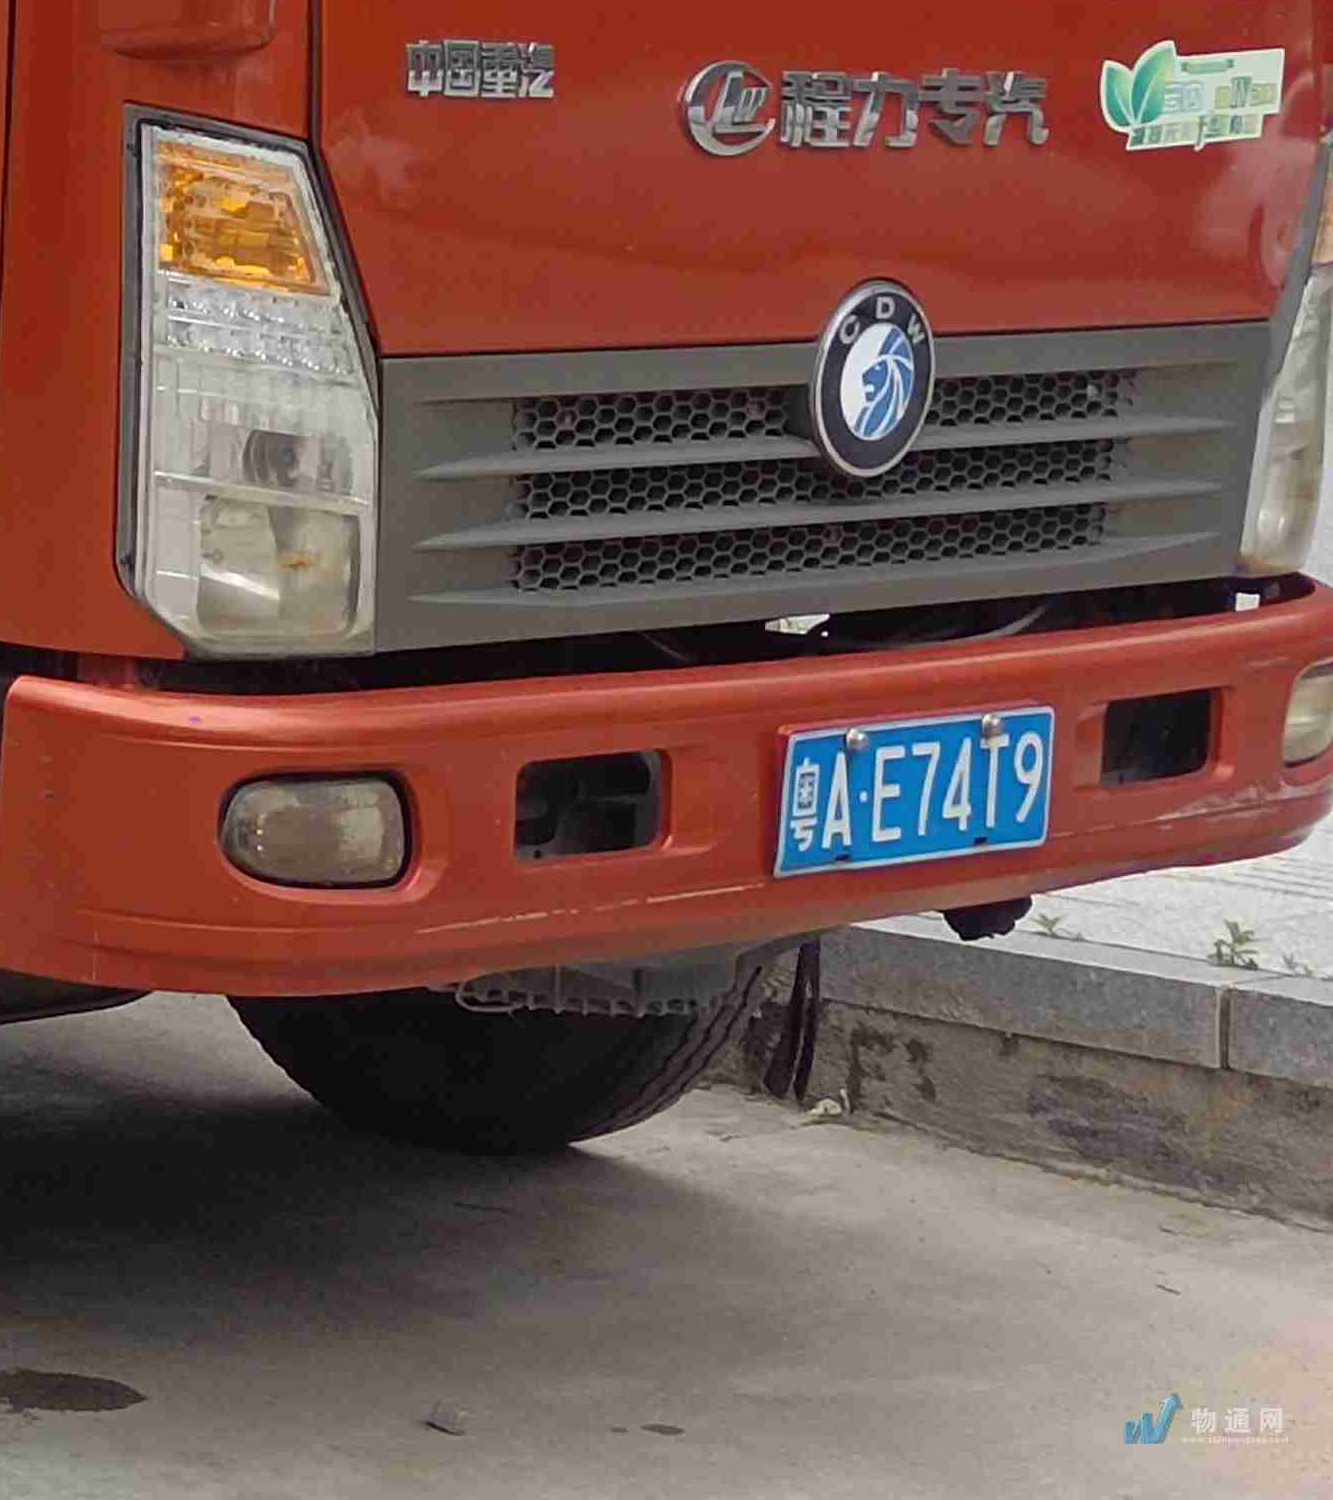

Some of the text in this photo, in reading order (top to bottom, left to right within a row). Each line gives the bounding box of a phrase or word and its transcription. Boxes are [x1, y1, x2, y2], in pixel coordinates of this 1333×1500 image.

[405, 39, 555, 99] 中国重汽
[779, 68, 1050, 148] 程力专汽
